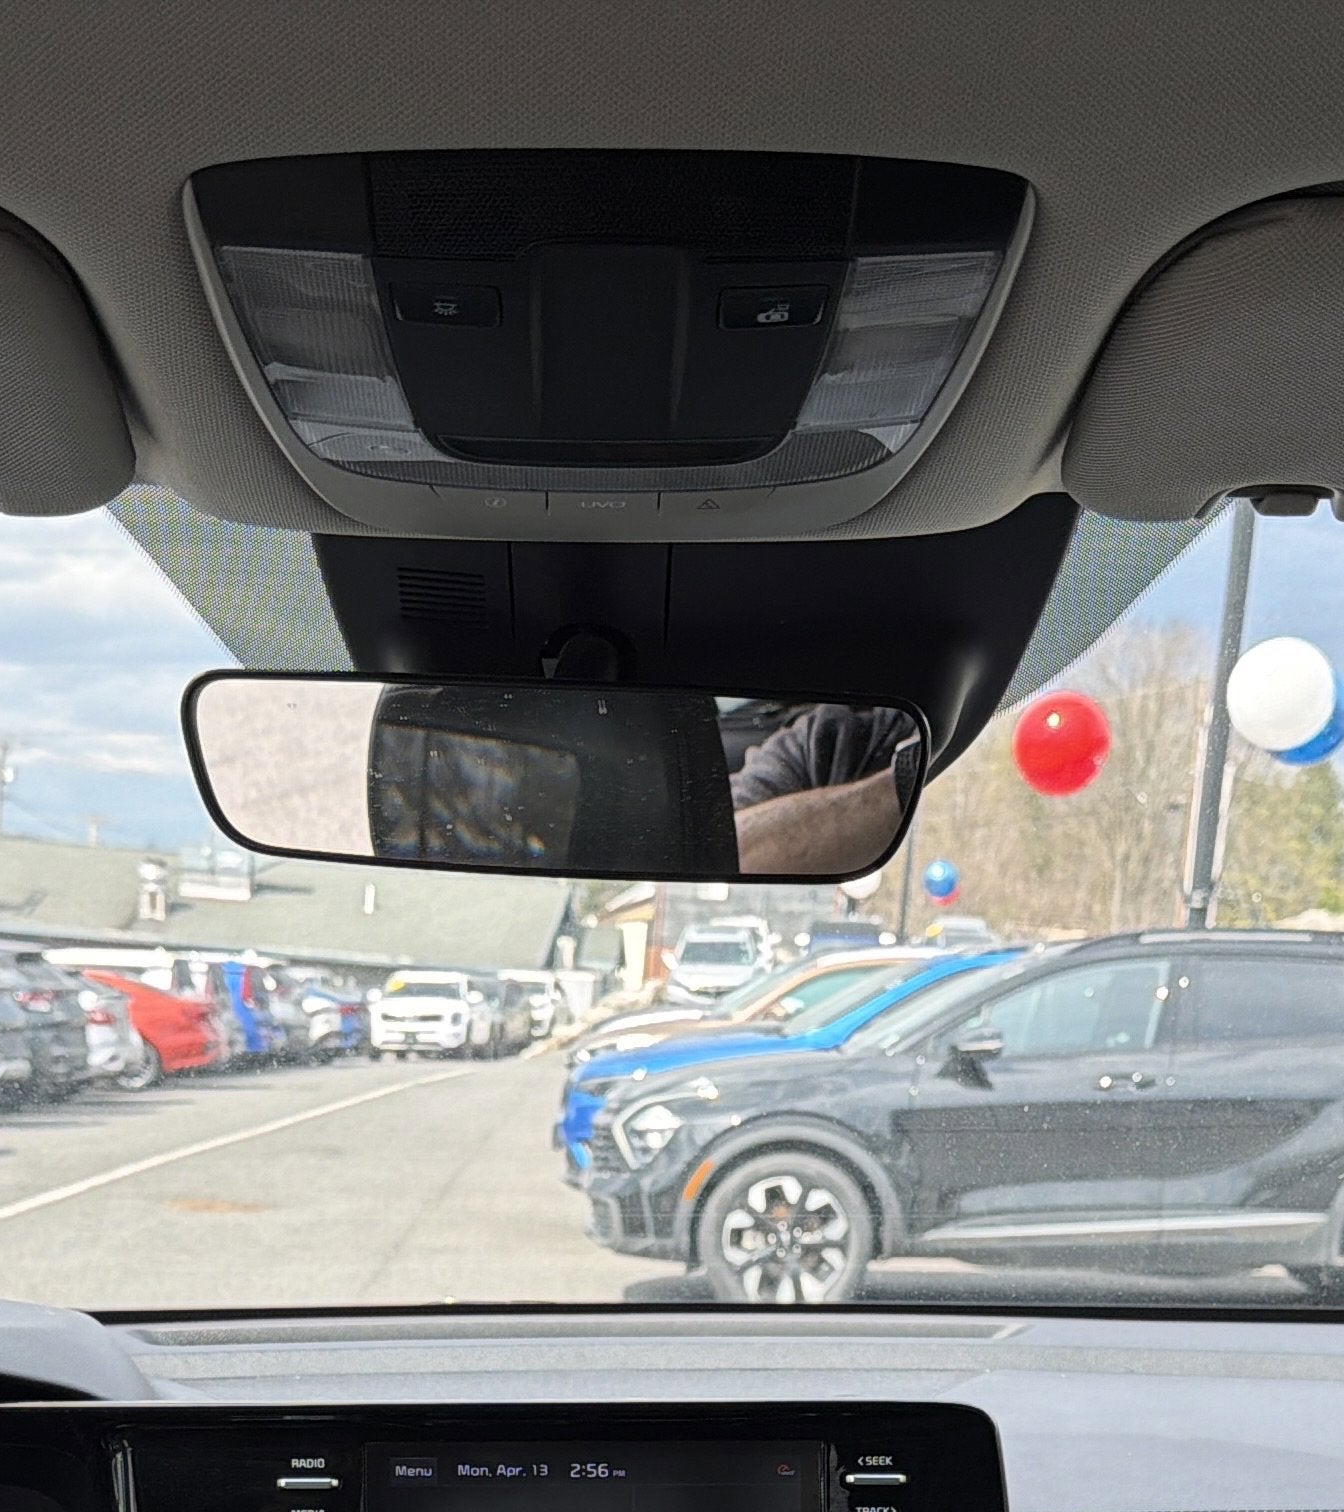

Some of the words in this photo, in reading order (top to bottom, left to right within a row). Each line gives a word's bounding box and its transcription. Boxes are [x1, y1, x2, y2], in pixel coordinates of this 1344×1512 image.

[580, 500, 626, 509] UVO
[291, 1458, 325, 1469] RADIO
[866, 1456, 893, 1465] SEEK
[395, 1465, 433, 1477] Menu
[496, 1464, 526, 1477] Apr.
[532, 1464, 548, 1476] 13
[570, 1463, 609, 1478] 2:56
